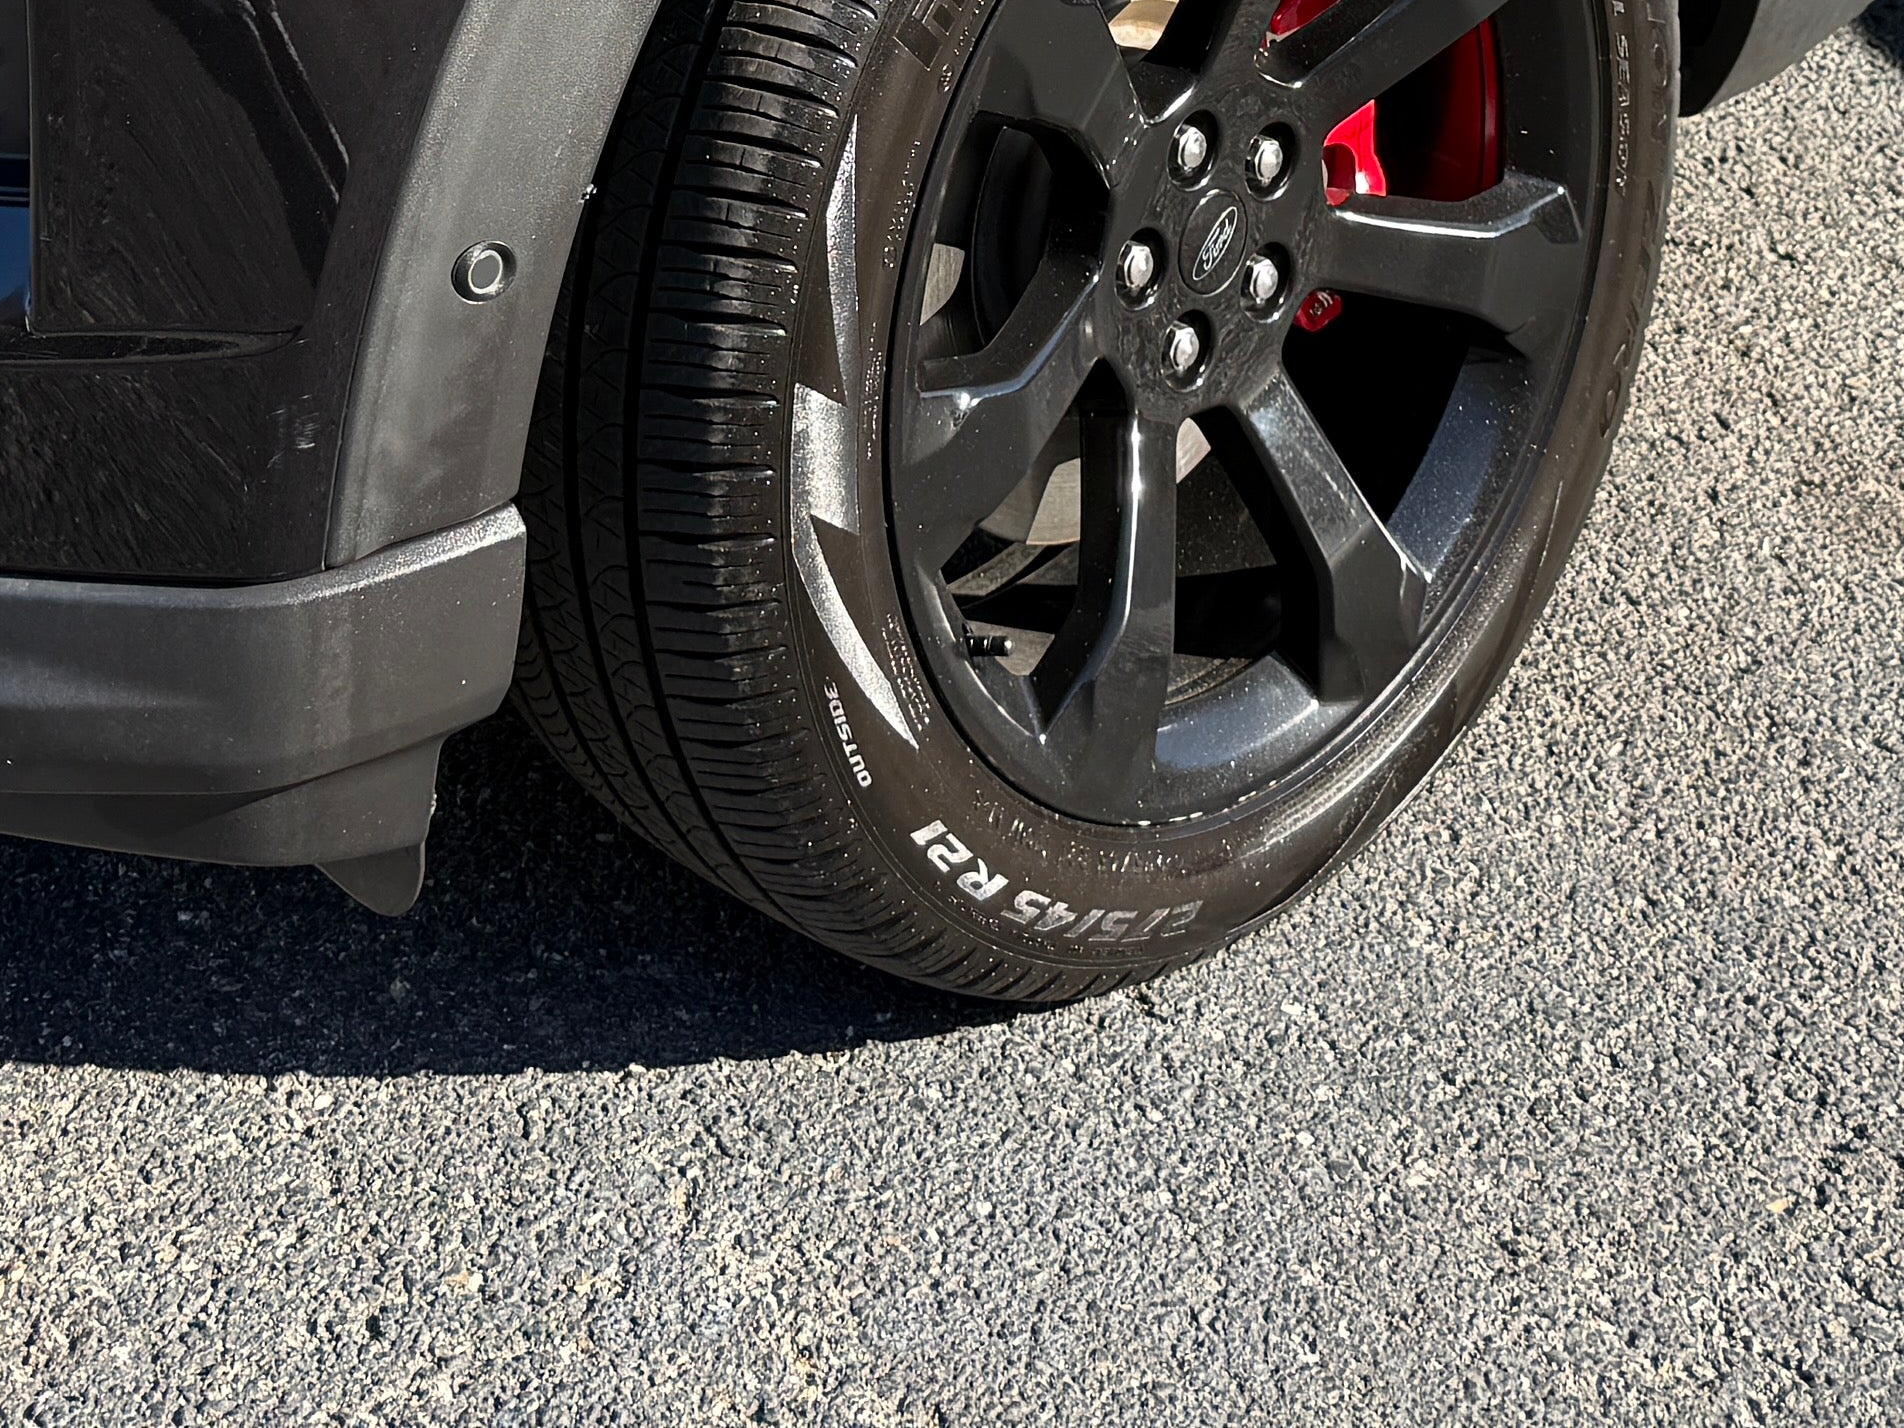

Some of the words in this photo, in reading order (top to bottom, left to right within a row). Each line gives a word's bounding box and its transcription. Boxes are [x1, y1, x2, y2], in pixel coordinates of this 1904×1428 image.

[1615, 32, 1632, 197] SEASON
[823, 675, 873, 789] OUTSIDE
[909, 819, 1010, 902] R21
[1000, 888, 1204, 944] 275/45
